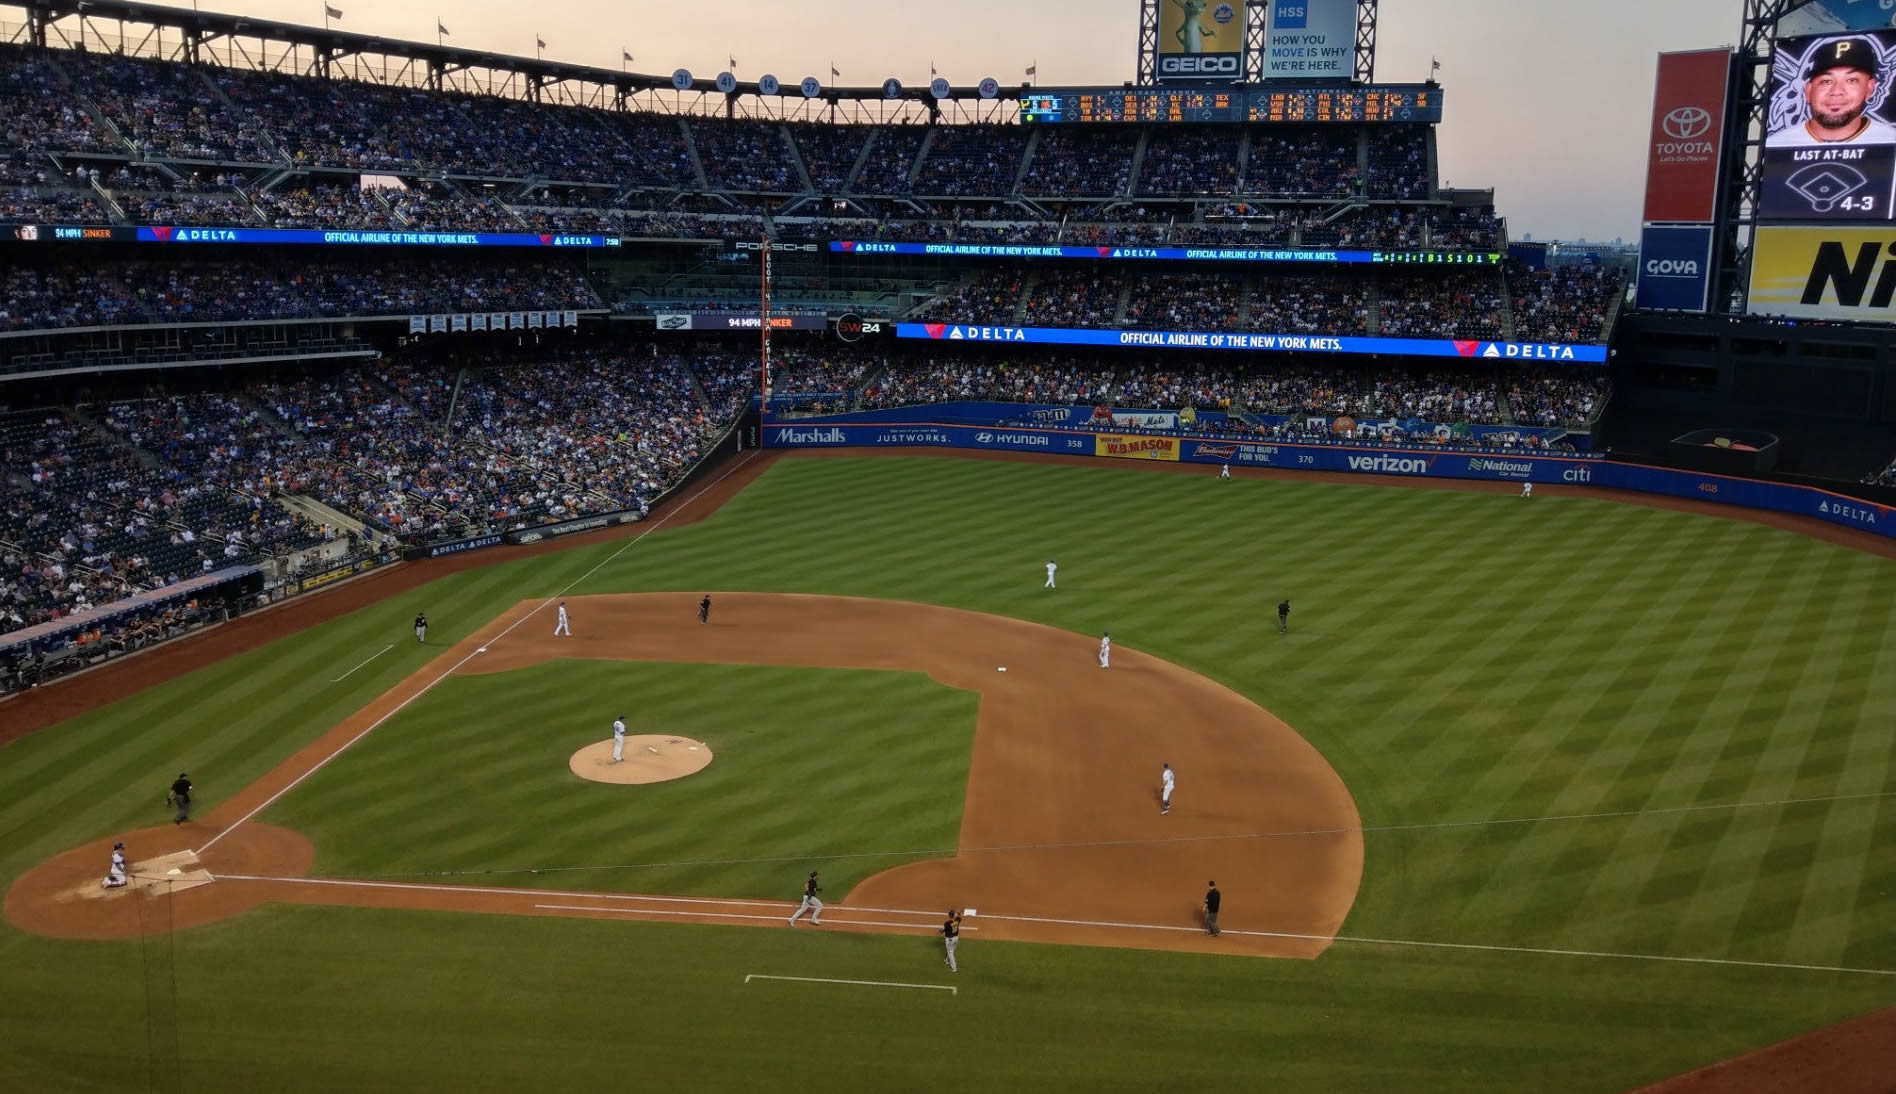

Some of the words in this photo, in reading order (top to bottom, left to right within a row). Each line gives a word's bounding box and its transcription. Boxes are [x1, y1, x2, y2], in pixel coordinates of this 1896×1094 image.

[1278, 7, 1304, 17] HSS
[1272, 35, 1299, 45] HOW
[1302, 35, 1325, 44] YOU
[1272, 48, 1304, 57] MOVE
[1307, 48, 1317, 56] IS
[1321, 47, 1347, 56] WHY
[1836, 42, 1851, 58] P
[1162, 56, 1237, 72] GEICO
[1271, 61, 1305, 70] WE'RE
[1308, 60, 1340, 70] HERE.
[677, 75, 688, 85] 31
[721, 77, 731, 86] 41
[764, 80, 774, 89] 14
[805, 82, 816, 91] 37
[982, 83, 994, 93] 42
[1656, 142, 1713, 154] TOYOTA
[1794, 150, 1820, 161] LAST
[1823, 149, 1864, 160] AT-BAT
[1840, 197, 1873, 210] 4-3
[65, 228, 81, 238] MPH
[83, 229, 111, 238] SINKER
[191, 231, 236, 240] DELTA
[325, 232, 359, 242] OFFICIAL
[361, 233, 390, 242] AIRLINE
[392, 234, 401, 242] OF
[403, 234, 418, 242] THE
[418, 234, 435, 243] NEW
[437, 234, 456, 243] YORK
[457, 235, 478, 243] METS.
[1647, 260, 1697, 275] GOYA
[728, 318, 740, 327] 94
[742, 318, 761, 327] MPH
[968, 328, 1024, 340] DELTA
[1121, 333, 1165, 345] OFFICIAL
[1167, 334, 1208, 345] AIRLINE
[1210, 335, 1225, 346] OF
[1227, 335, 1247, 347] THE
[1250, 336, 1275, 348] NEW
[1278, 337, 1307, 348] YORK
[1310, 338, 1342, 350] METS.
[1506, 344, 1574, 358] DELTA
[774, 427, 846, 443] Marshalls
[997, 434, 1048, 446] HYUNDAI
[1129, 440, 1173, 453] MASON
[1348, 452, 1426, 473] verizon
[1482, 460, 1532, 472] National
[1563, 468, 1590, 481] citi
[1698, 483, 1718, 493] 408
[1833, 504, 1875, 524] DELTA
[476, 536, 501, 545] DELTA
[440, 544, 465, 552] DELTA
